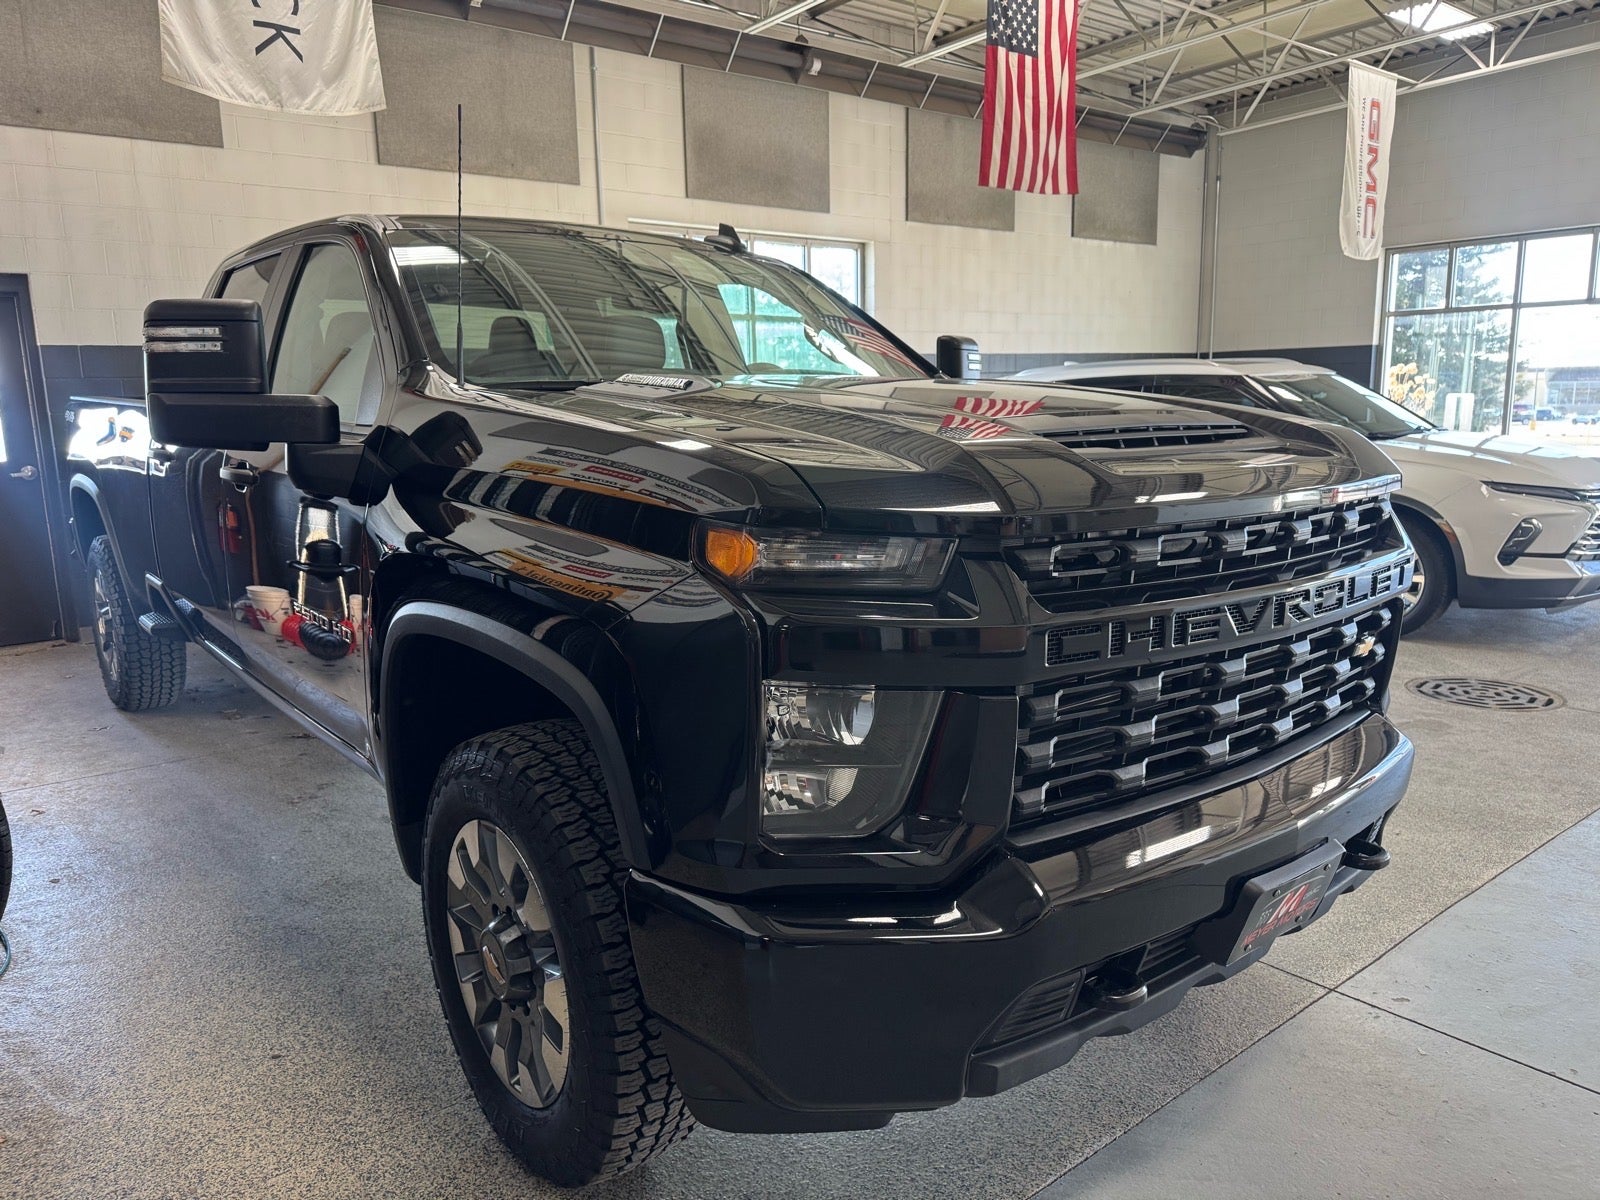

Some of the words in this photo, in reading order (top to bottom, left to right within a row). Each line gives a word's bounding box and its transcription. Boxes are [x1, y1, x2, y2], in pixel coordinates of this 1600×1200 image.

[1363, 98, 1381, 239] GMC
[293, 601, 329, 631] 2500
[331, 620, 352, 644] HD
[1045, 556, 1411, 667] CHEVROLET
[1241, 918, 1278, 947] MEYER
